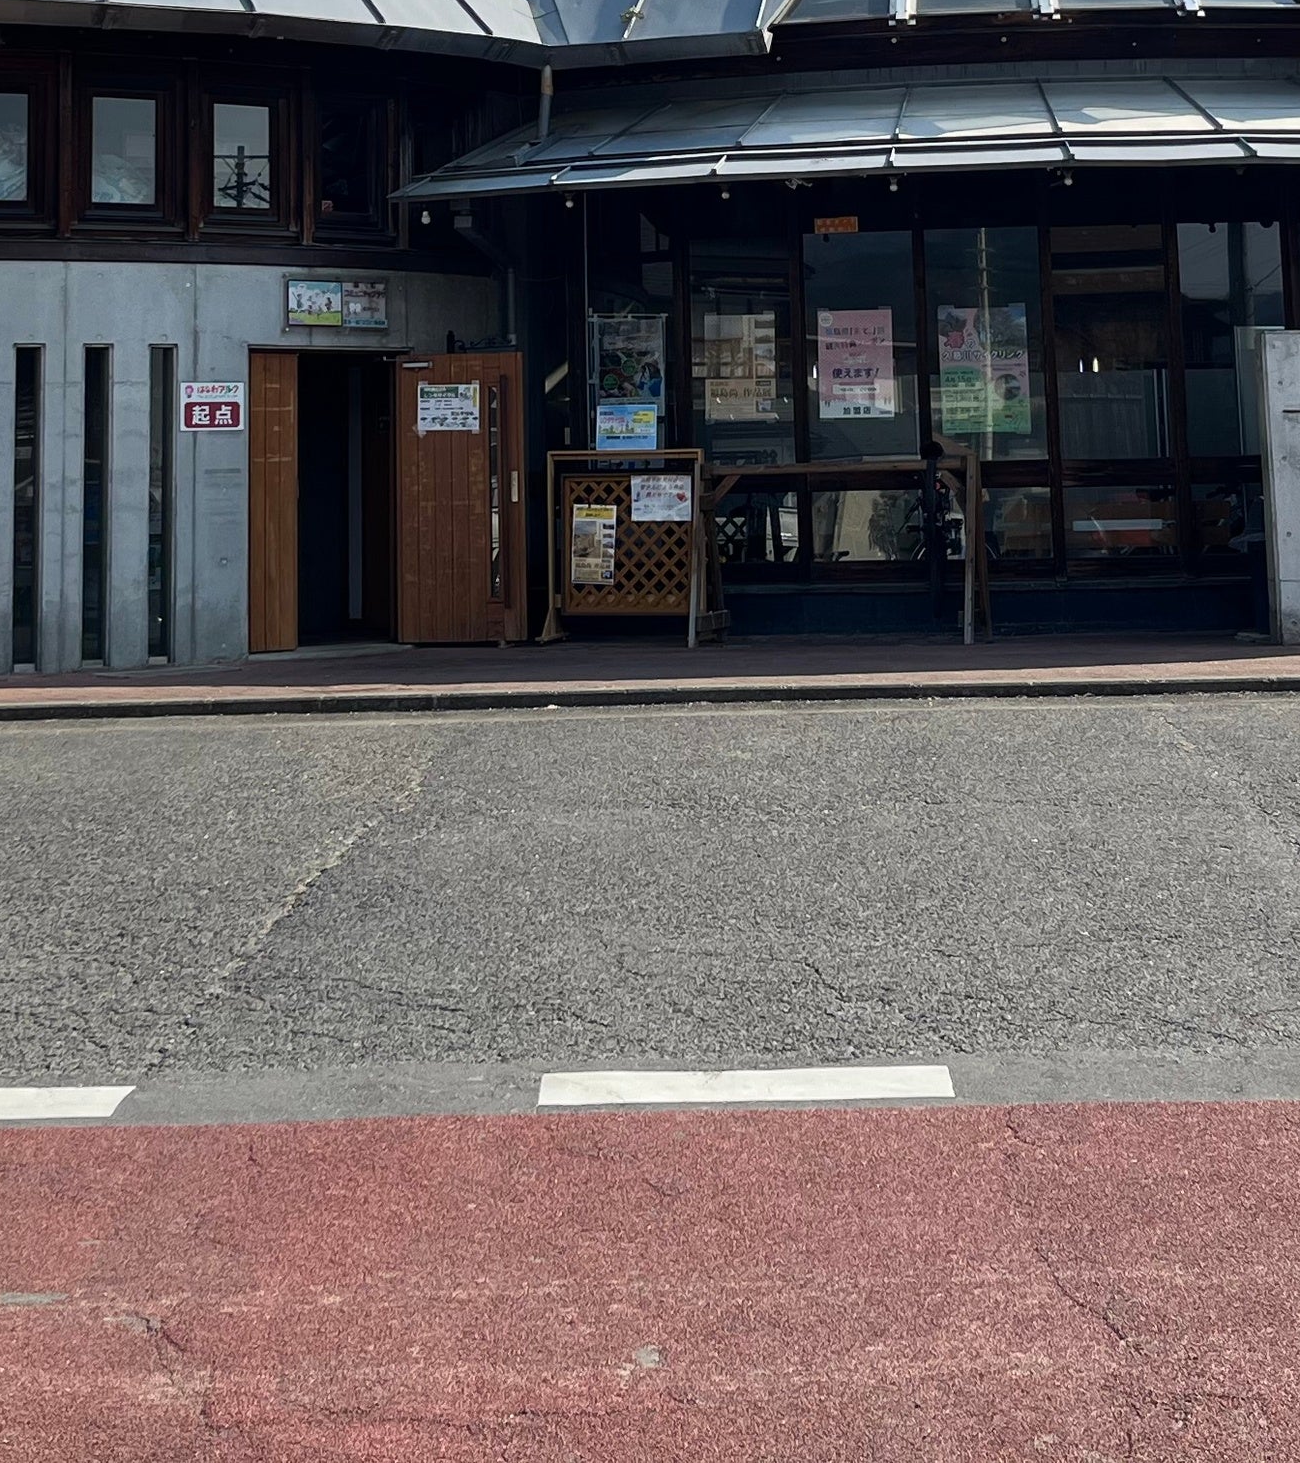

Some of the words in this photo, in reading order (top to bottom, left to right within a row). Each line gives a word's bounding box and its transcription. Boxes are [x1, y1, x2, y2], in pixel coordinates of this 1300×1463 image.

[191, 404, 233, 425] 起点
[842, 406, 872, 415] 加盟店
